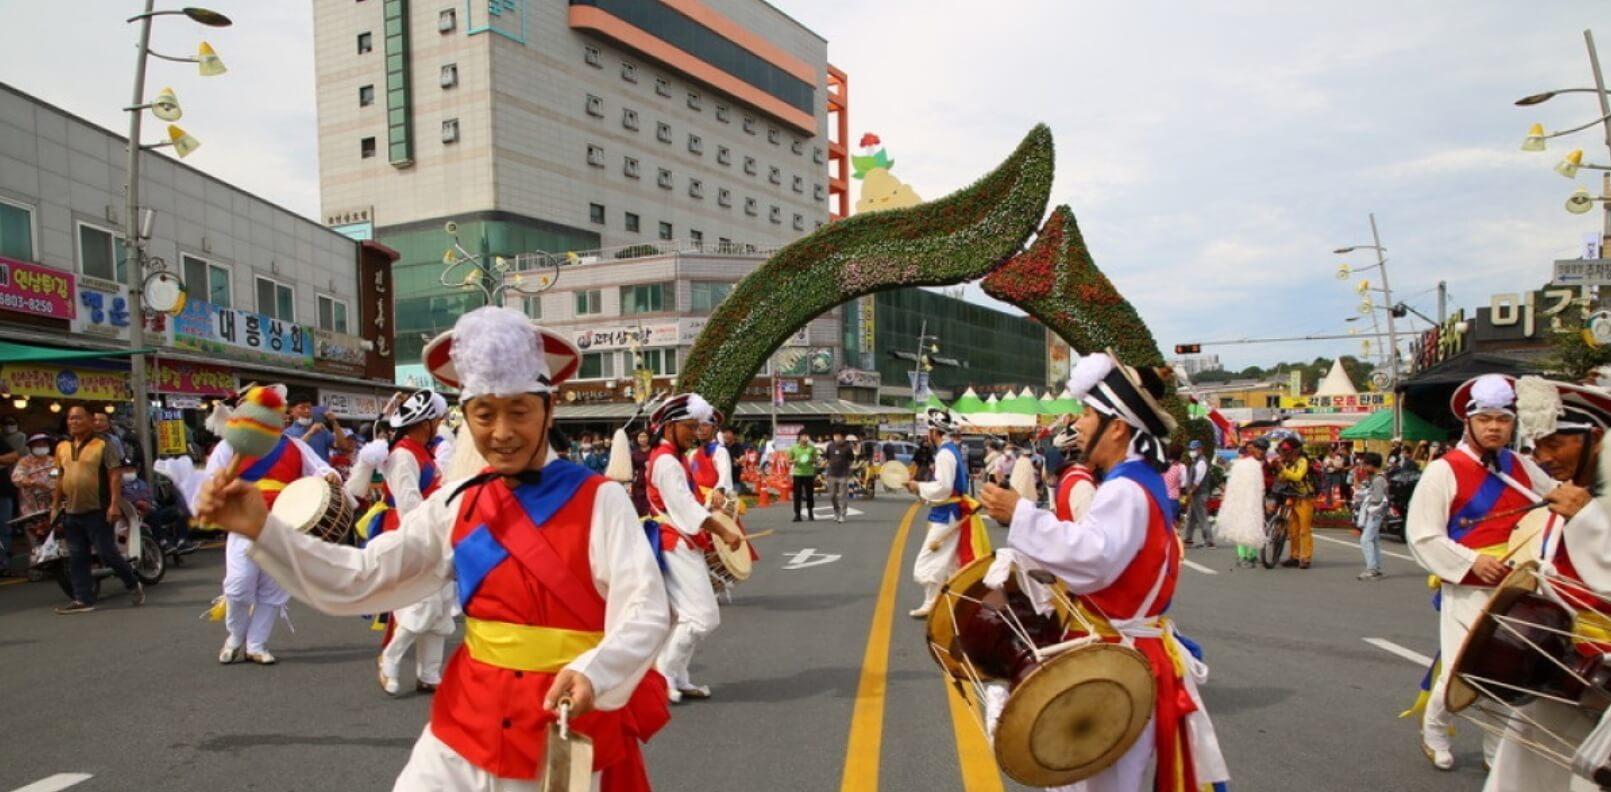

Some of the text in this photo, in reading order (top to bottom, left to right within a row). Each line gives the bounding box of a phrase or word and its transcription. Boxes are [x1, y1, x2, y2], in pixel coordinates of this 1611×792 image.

[219, 308, 304, 354] 대흥상회
[1333, 395, 1357, 406] 모종
[1359, 394, 1384, 405] 판매
